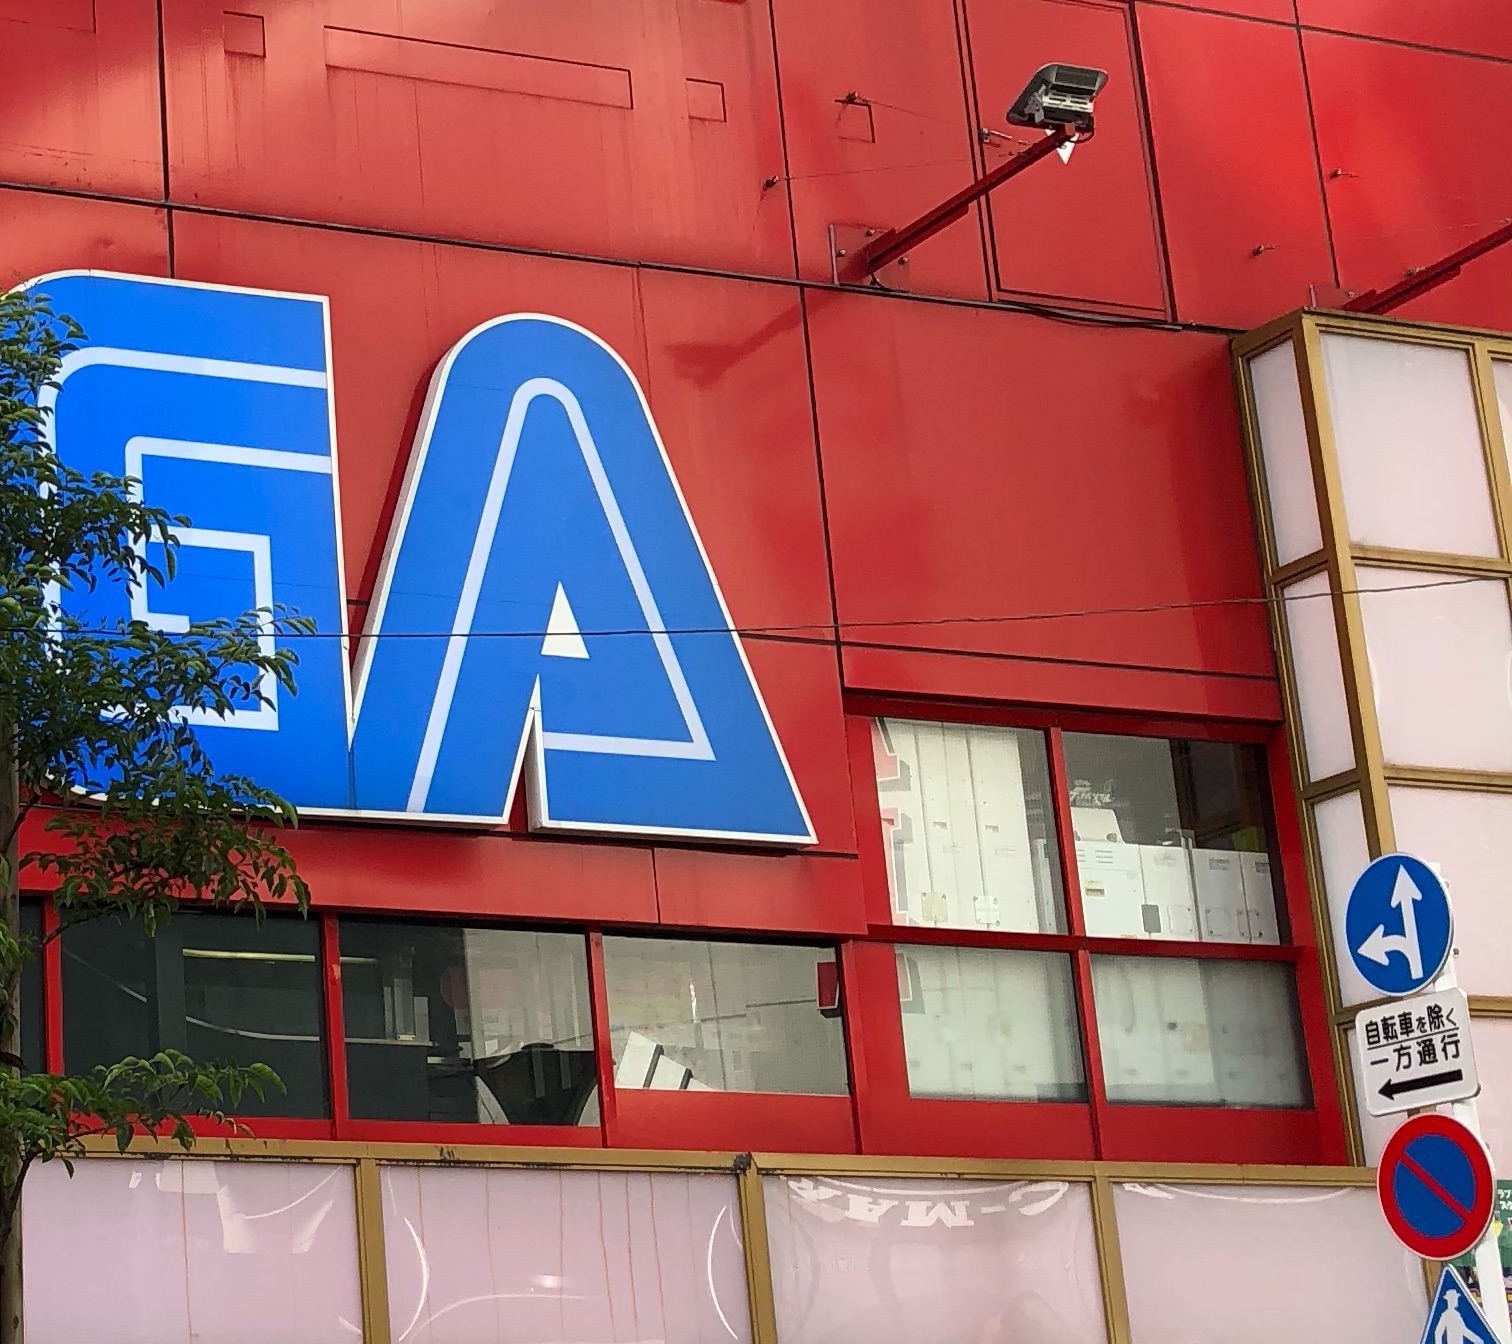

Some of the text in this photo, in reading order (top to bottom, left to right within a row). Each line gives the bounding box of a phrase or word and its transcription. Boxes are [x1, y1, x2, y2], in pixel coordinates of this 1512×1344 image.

[1364, 1003, 1458, 1047] 自転車を除く
[1369, 1032, 1461, 1074] 一方通行
